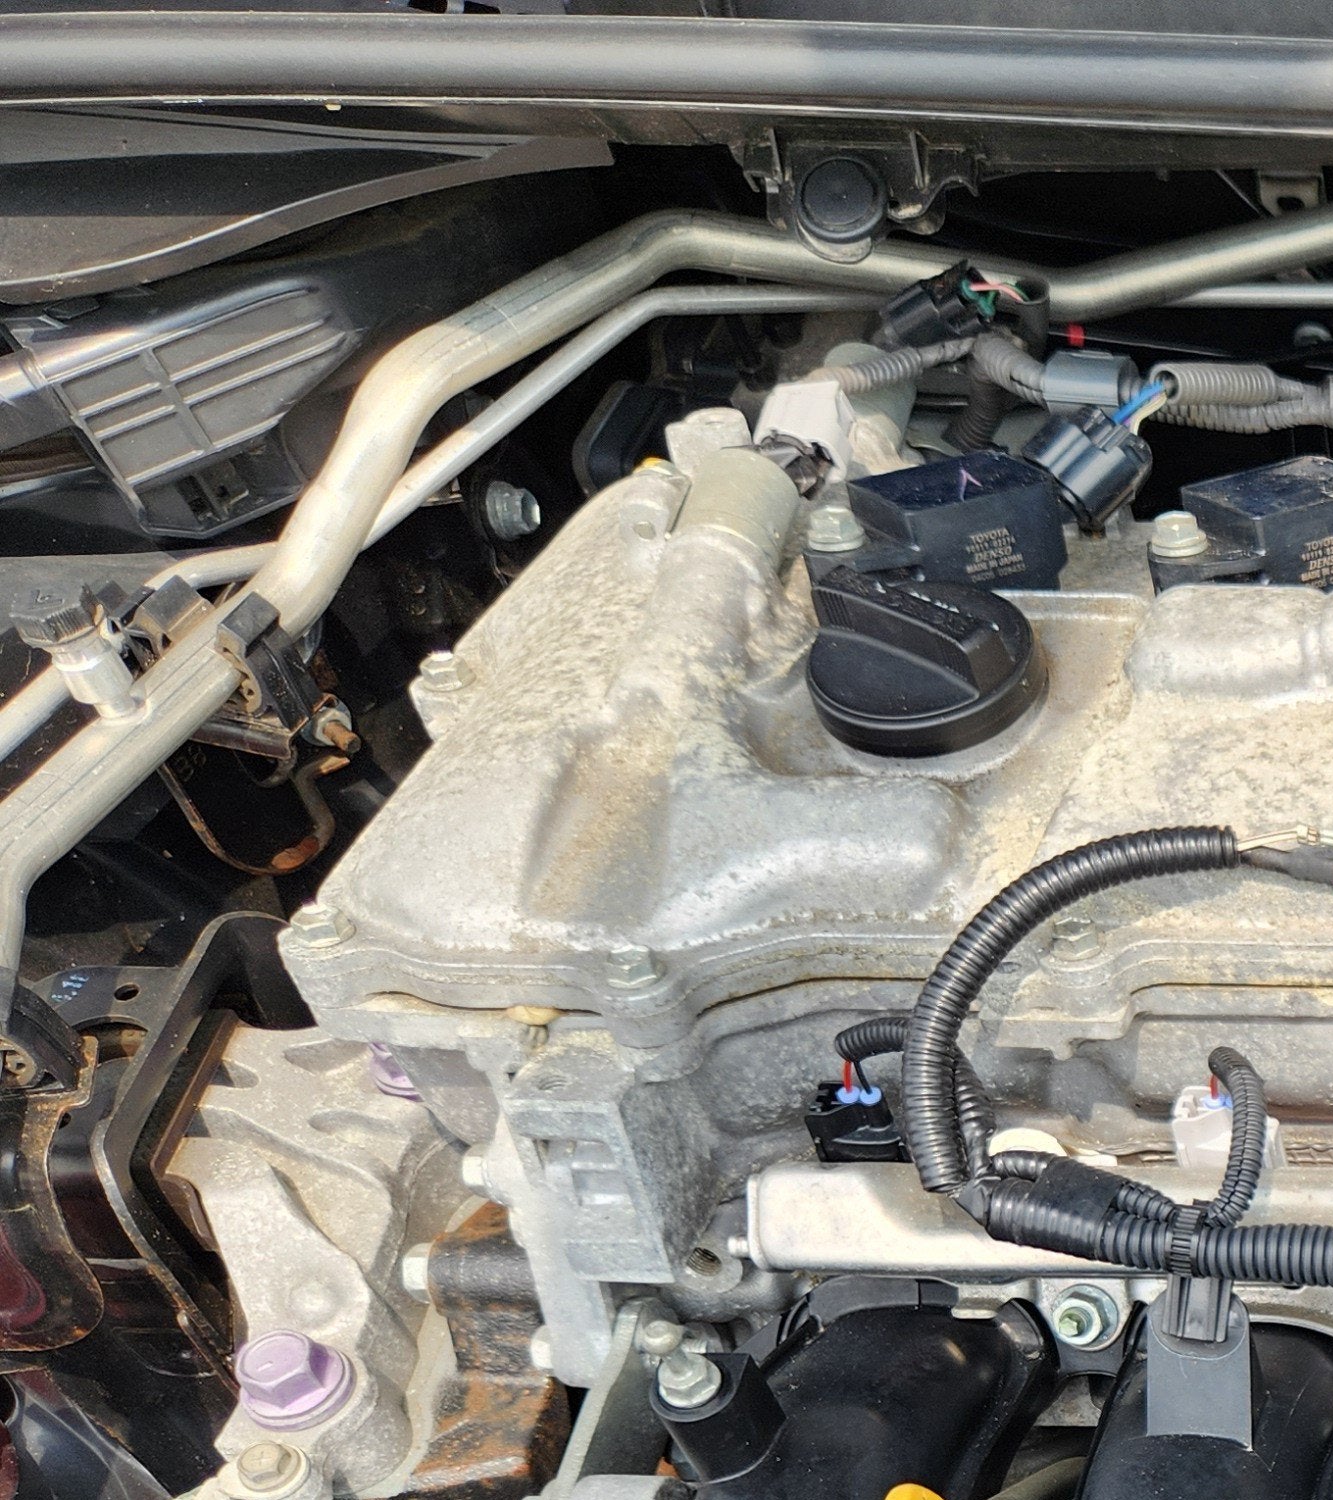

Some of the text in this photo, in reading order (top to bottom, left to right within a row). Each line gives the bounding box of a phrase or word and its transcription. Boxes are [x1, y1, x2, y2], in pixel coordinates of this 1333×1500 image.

[969, 527, 1010, 544] TOYOTA
[974, 545, 1012, 563] DENSO
[966, 562, 987, 574] MADE
[998, 553, 1024, 566] JAPAN
[1301, 570, 1320, 582] MADE
